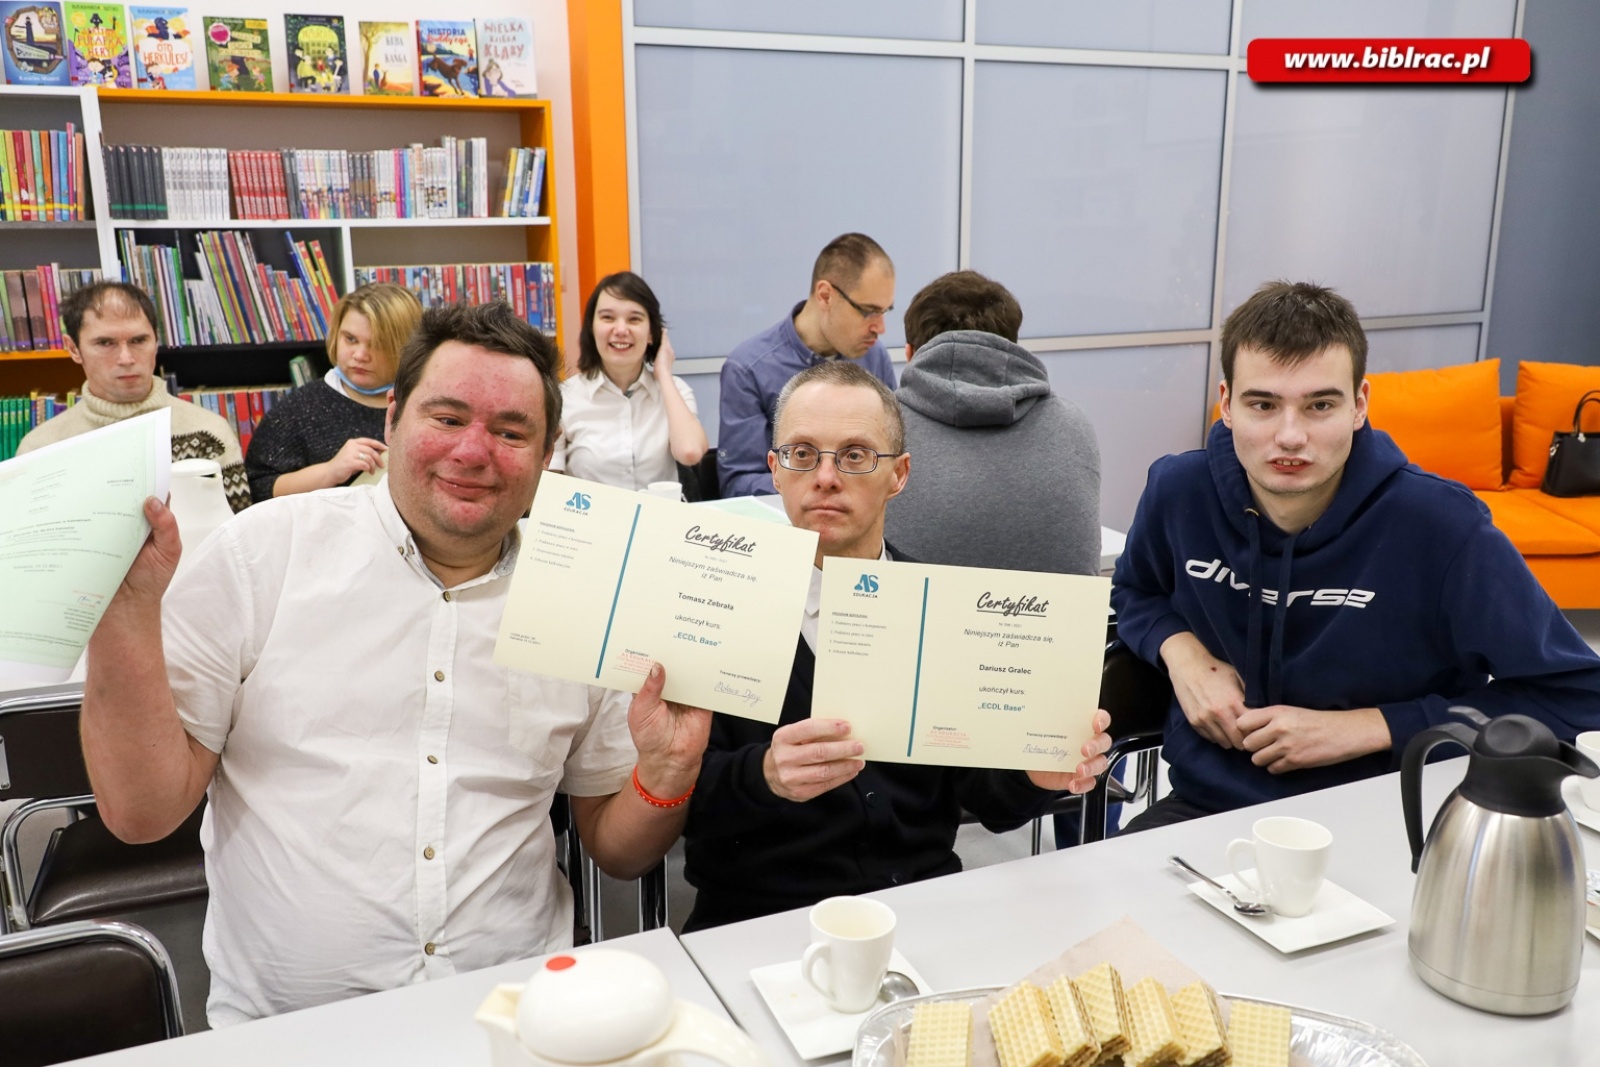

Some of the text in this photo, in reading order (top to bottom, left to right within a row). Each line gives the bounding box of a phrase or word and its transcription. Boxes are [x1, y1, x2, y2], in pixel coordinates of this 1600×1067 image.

[428, 28, 466, 36] HISTORIA
[484, 22, 524, 33] WIELKA
[156, 43, 173, 53] OTO
[483, 44, 525, 61] KLARY
[684, 525, 757, 553] Certyfikat
[668, 556, 706, 570] Niniejszym
[706, 564, 746, 580] zaświadcza
[708, 573, 723, 583] Pan
[854, 573, 879, 593] AS
[678, 592, 706, 604] Tomasz
[976, 591, 1050, 617] Certyfikat
[963, 628, 1001, 640] Niniejszym
[1001, 632, 1042, 642] zaświadcza
[1005, 640, 1020, 649] Pan
[978, 664, 1032, 675] Dariusz Gralec
